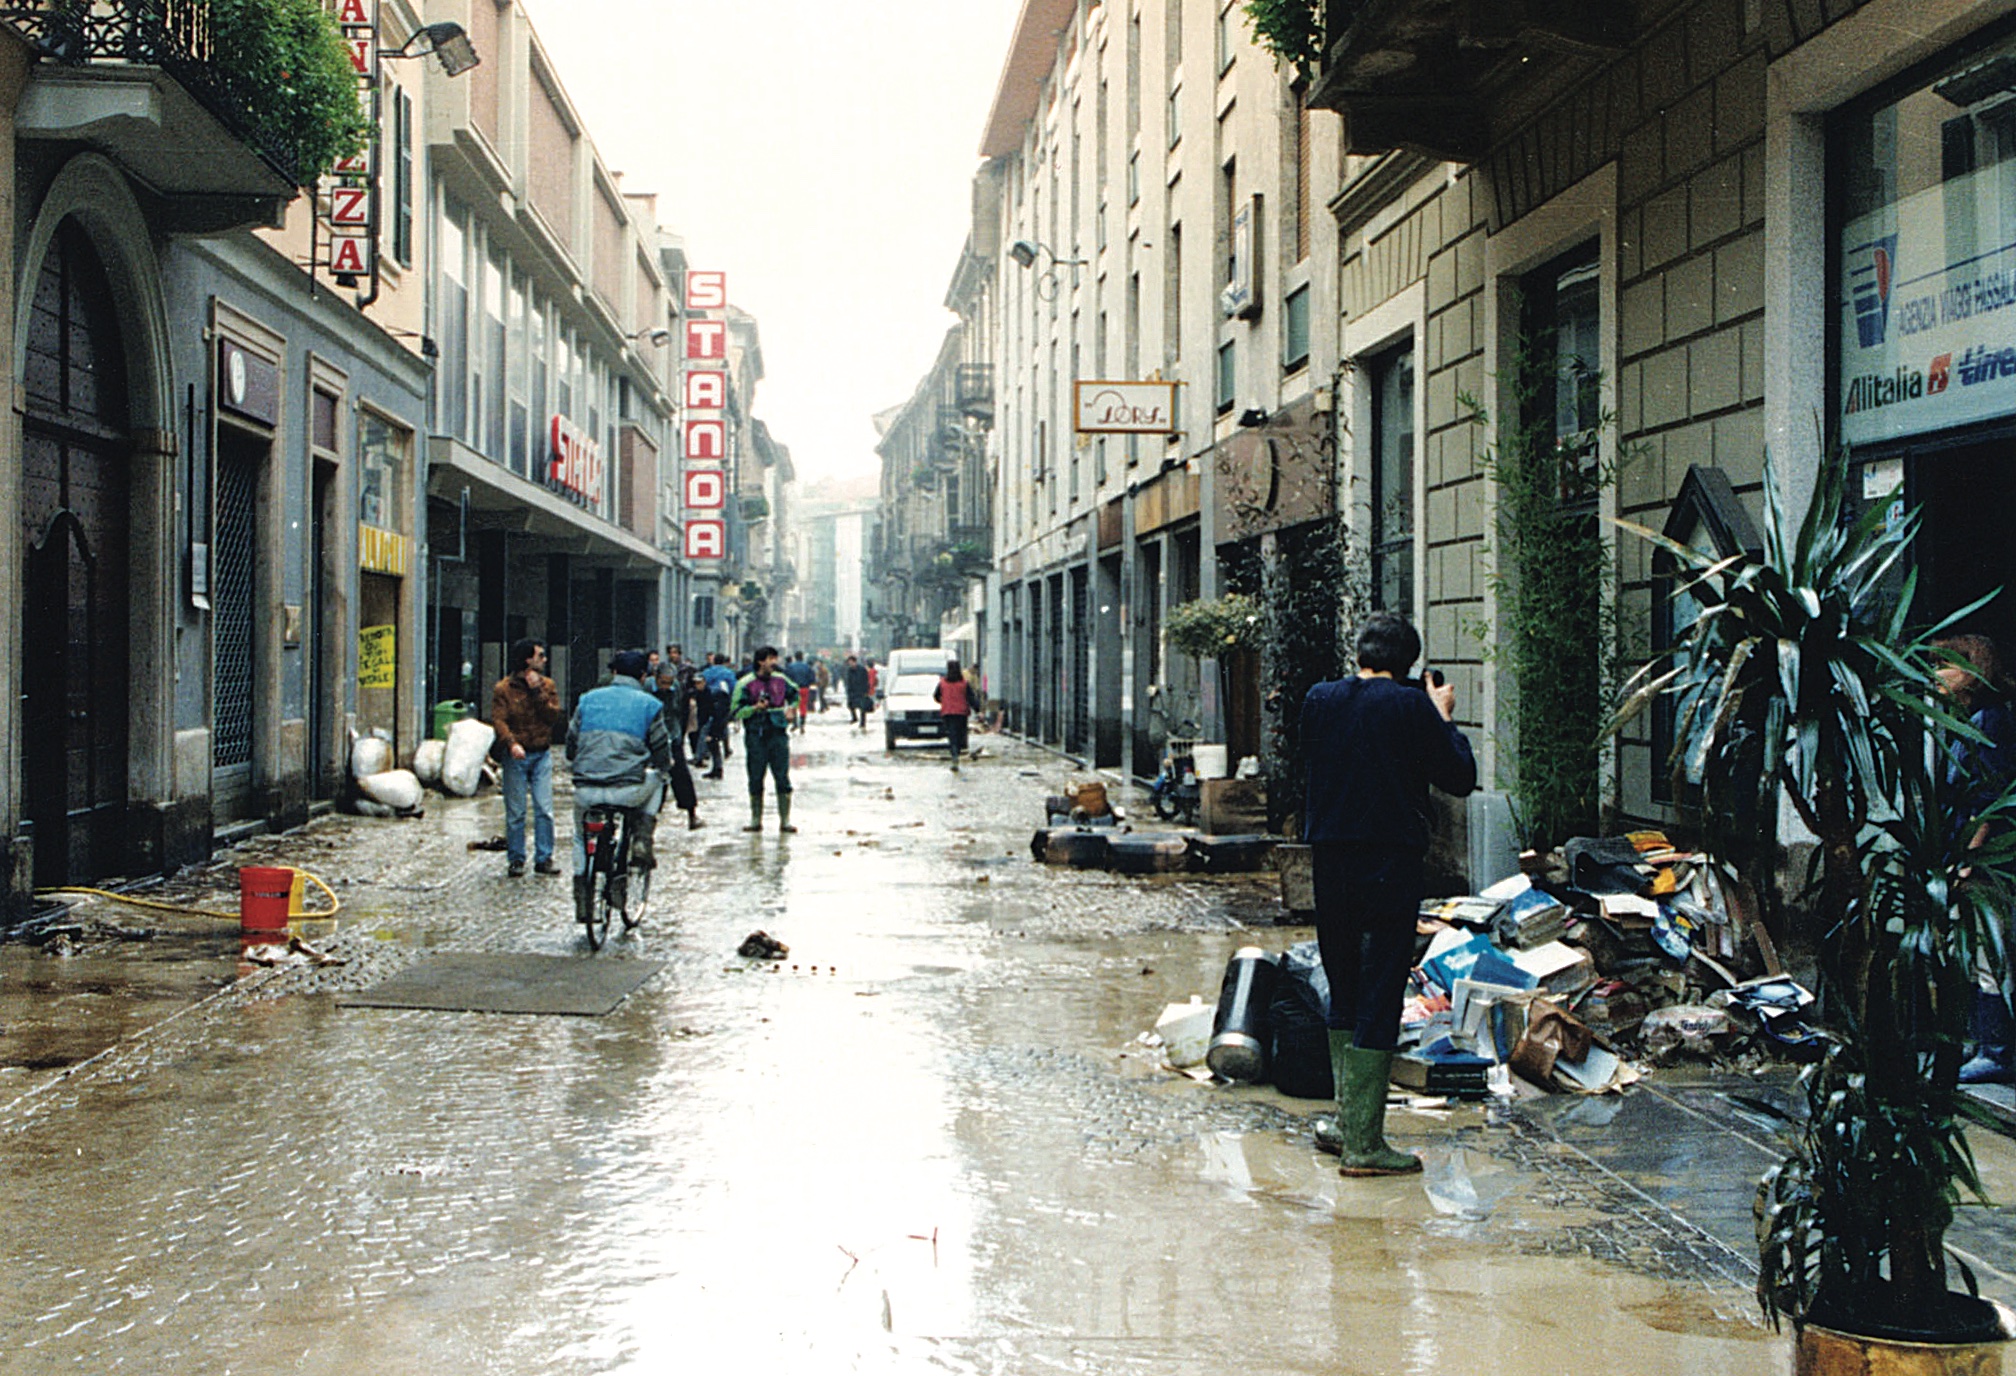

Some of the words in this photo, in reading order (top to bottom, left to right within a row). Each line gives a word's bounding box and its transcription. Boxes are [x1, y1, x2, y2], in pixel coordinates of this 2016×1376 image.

[333, 0, 369, 271] ANZZA
[688, 273, 724, 556] STANDA
[1845, 364, 1922, 415] Alitalia
